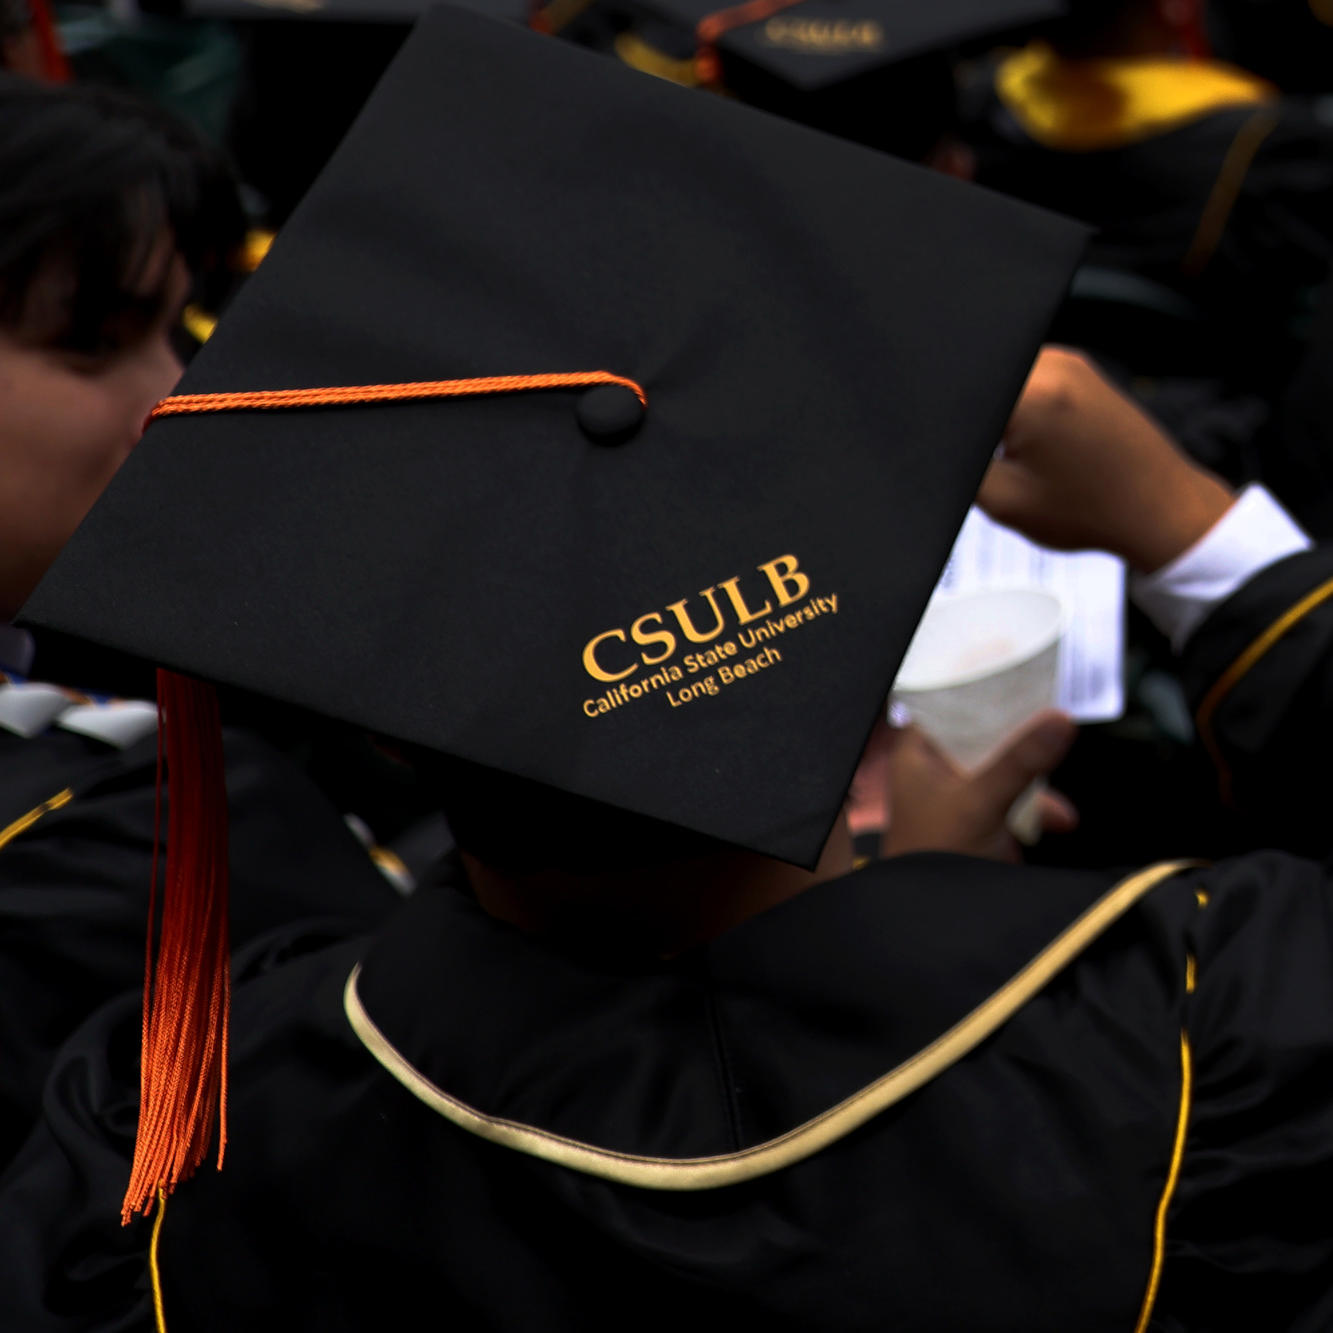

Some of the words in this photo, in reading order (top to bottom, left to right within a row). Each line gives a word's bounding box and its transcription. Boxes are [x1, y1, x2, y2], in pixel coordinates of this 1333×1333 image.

[582, 554, 810, 682] CSULB
[583, 665, 684, 718] California
[683, 641, 738, 673] State
[738, 592, 838, 648] University
[666, 676, 719, 707] Long
[718, 646, 783, 685] Beach
